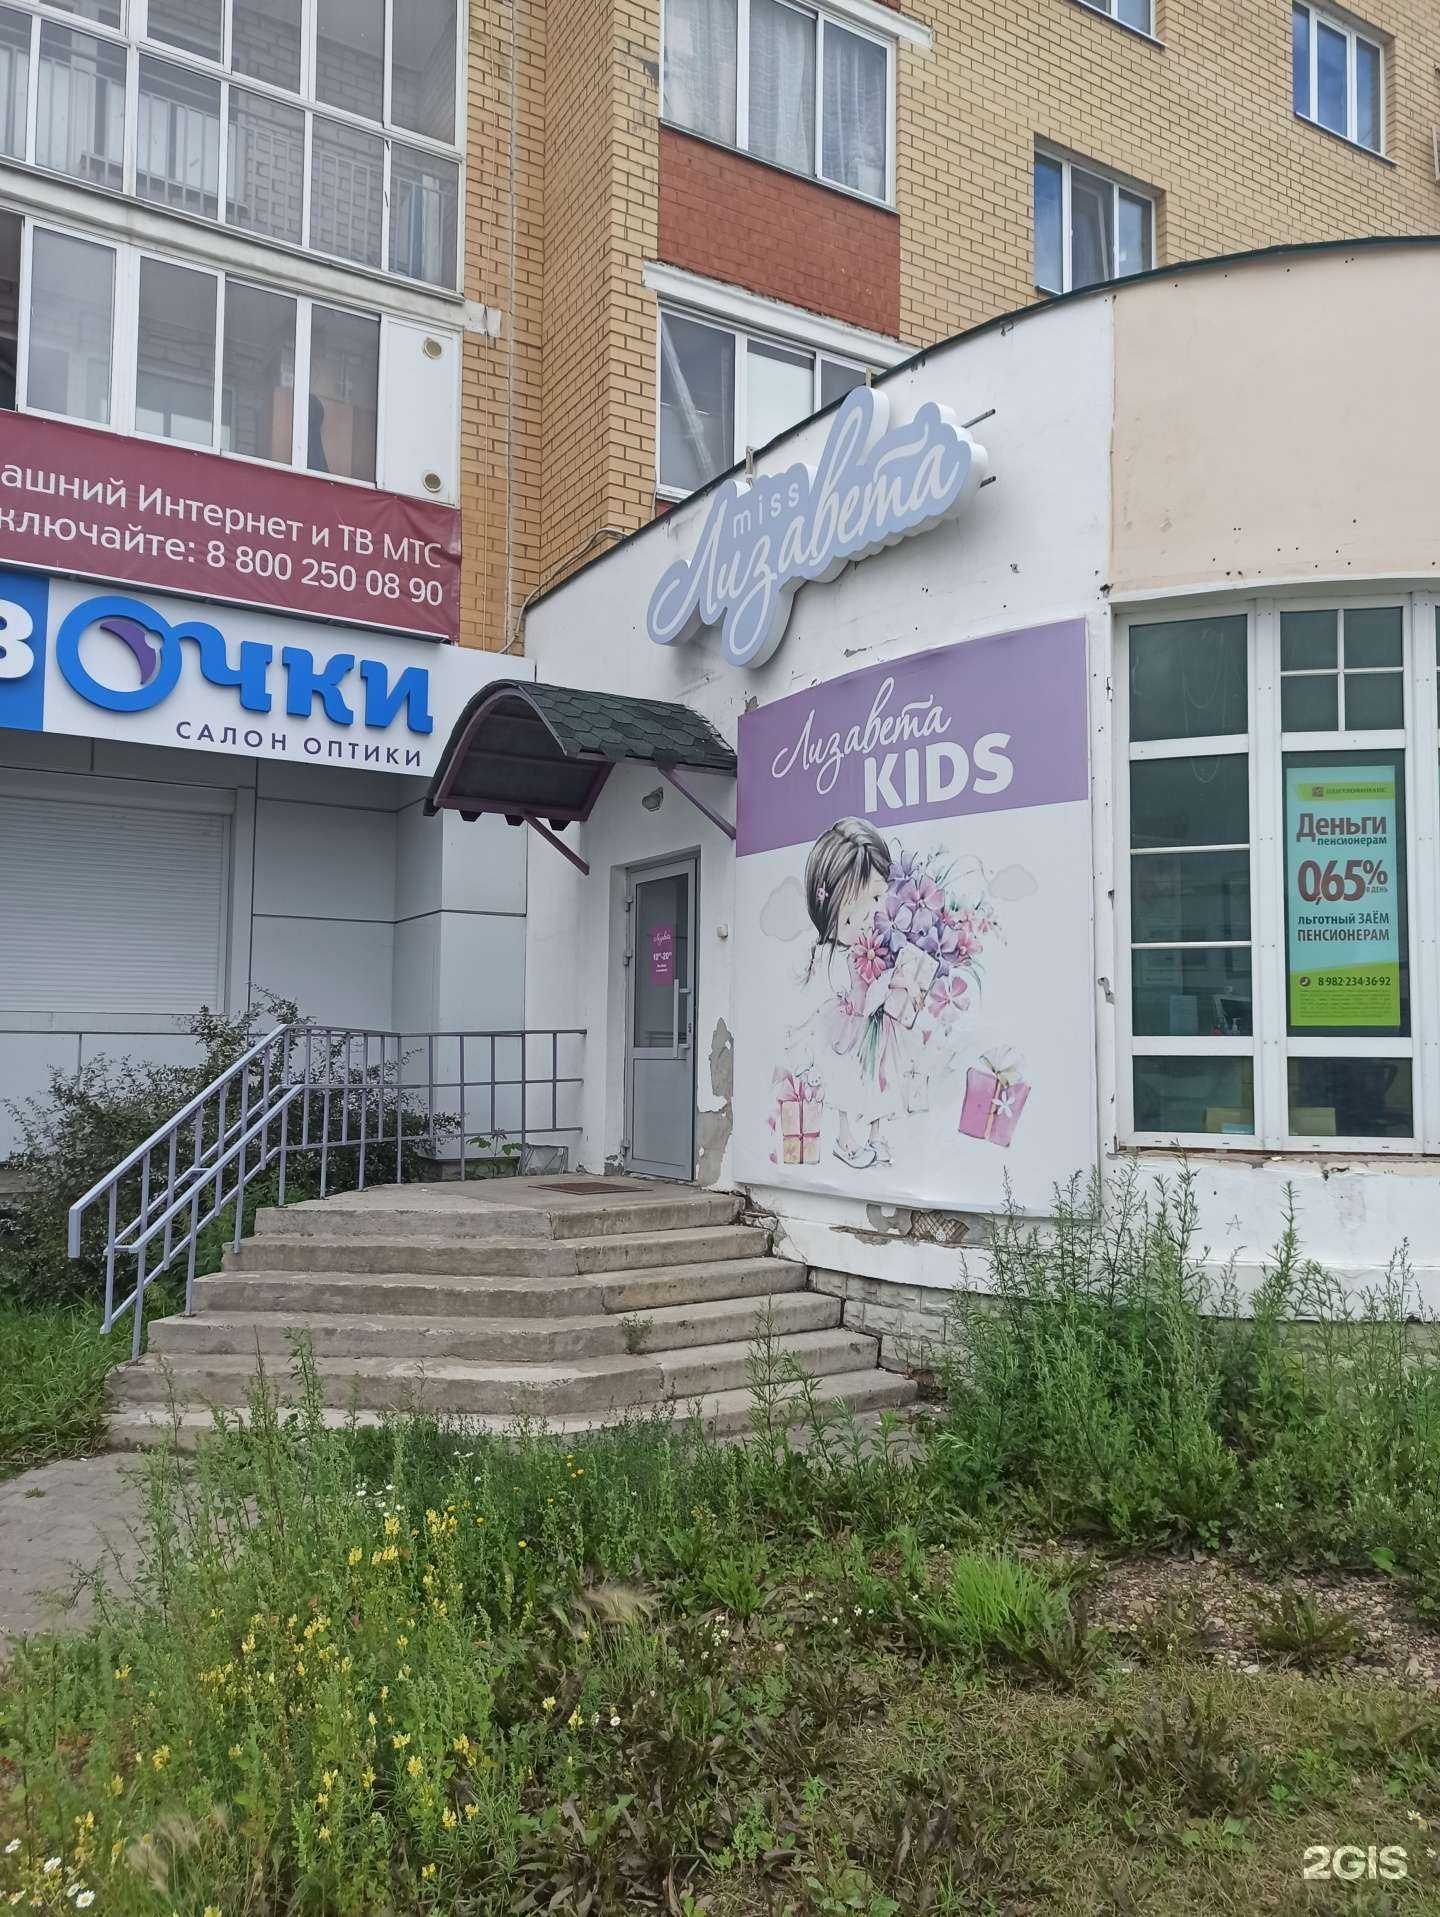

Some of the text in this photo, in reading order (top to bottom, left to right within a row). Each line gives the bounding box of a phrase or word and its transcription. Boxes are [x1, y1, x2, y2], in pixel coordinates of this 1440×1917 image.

[1, 464, 442, 568] ашний Интернет и ТВ МТС
[653, 406, 959, 655] Лизавета
[732, 480, 799, 538] miss
[0, 508, 443, 606] ключайте: 8 800 250 08 90
[176, 721, 421, 767] САЛОН ОПТИКИ
[771, 677, 952, 795] Лизавета
[864, 732, 1015, 813] KIDS
[1296, 812, 1387, 843] Деньги
[1317, 836, 1388, 847] пенсионерам
[1298, 910, 1390, 925] льготный ЗАЁМ
[1298, 929, 1390, 942] ПЕНСИОНЕРАМ
